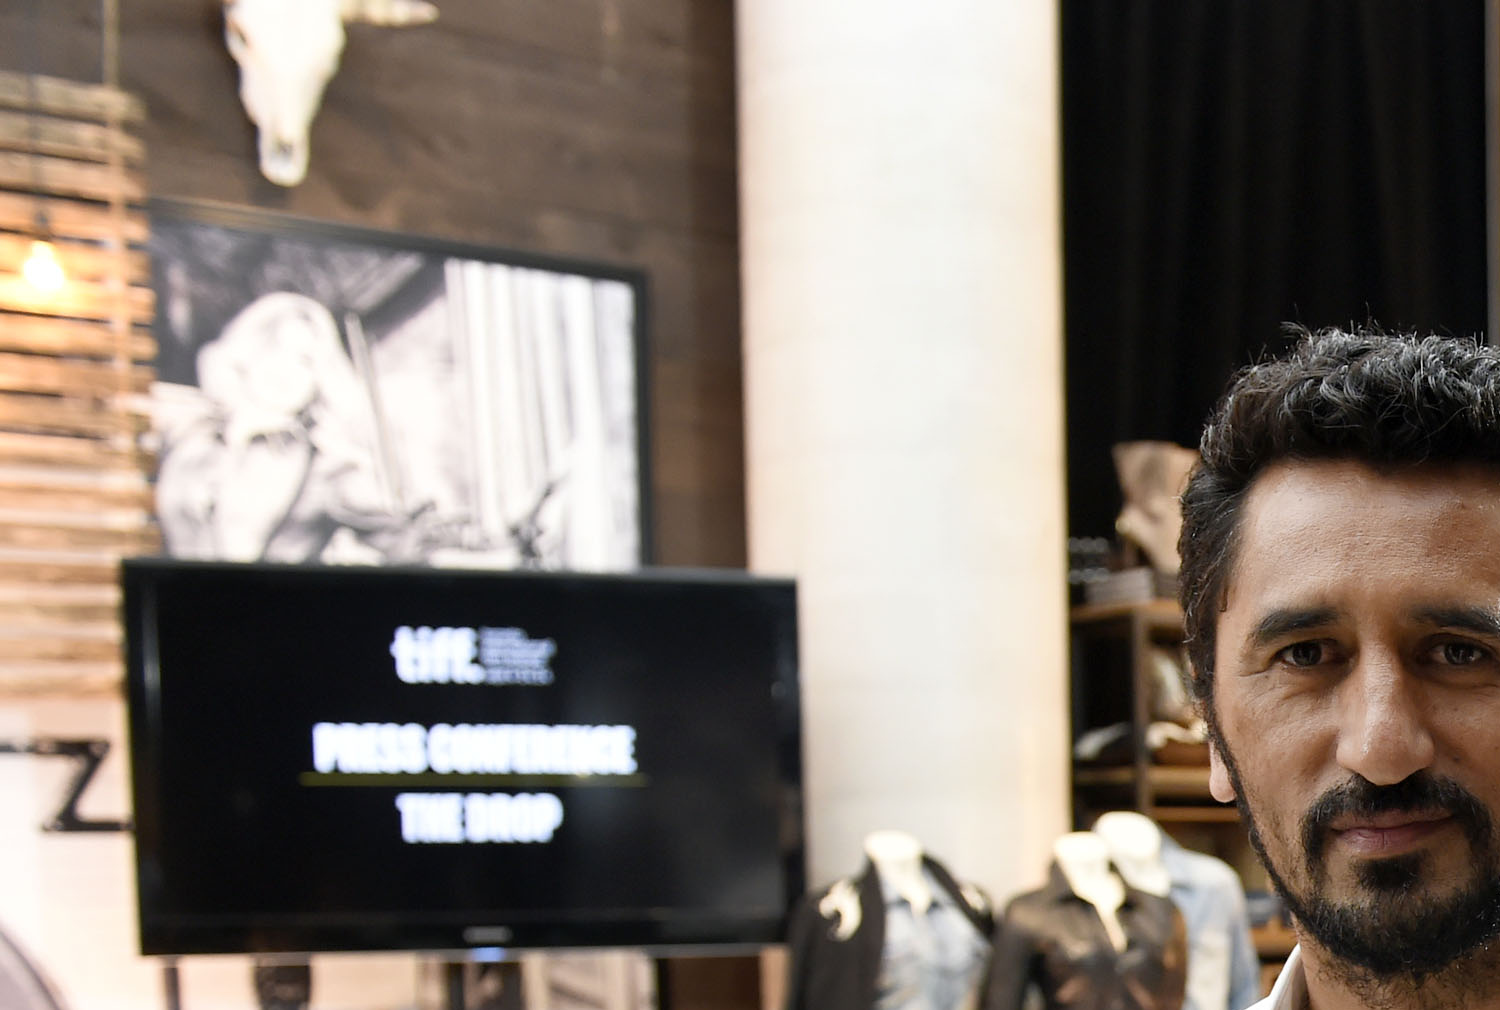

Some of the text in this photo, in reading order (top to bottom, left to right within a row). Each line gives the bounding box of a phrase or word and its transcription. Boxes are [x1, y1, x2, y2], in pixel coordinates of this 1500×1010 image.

[313, 723, 637, 774] PRESS CONFERENCE
[395, 793, 462, 842] THE
